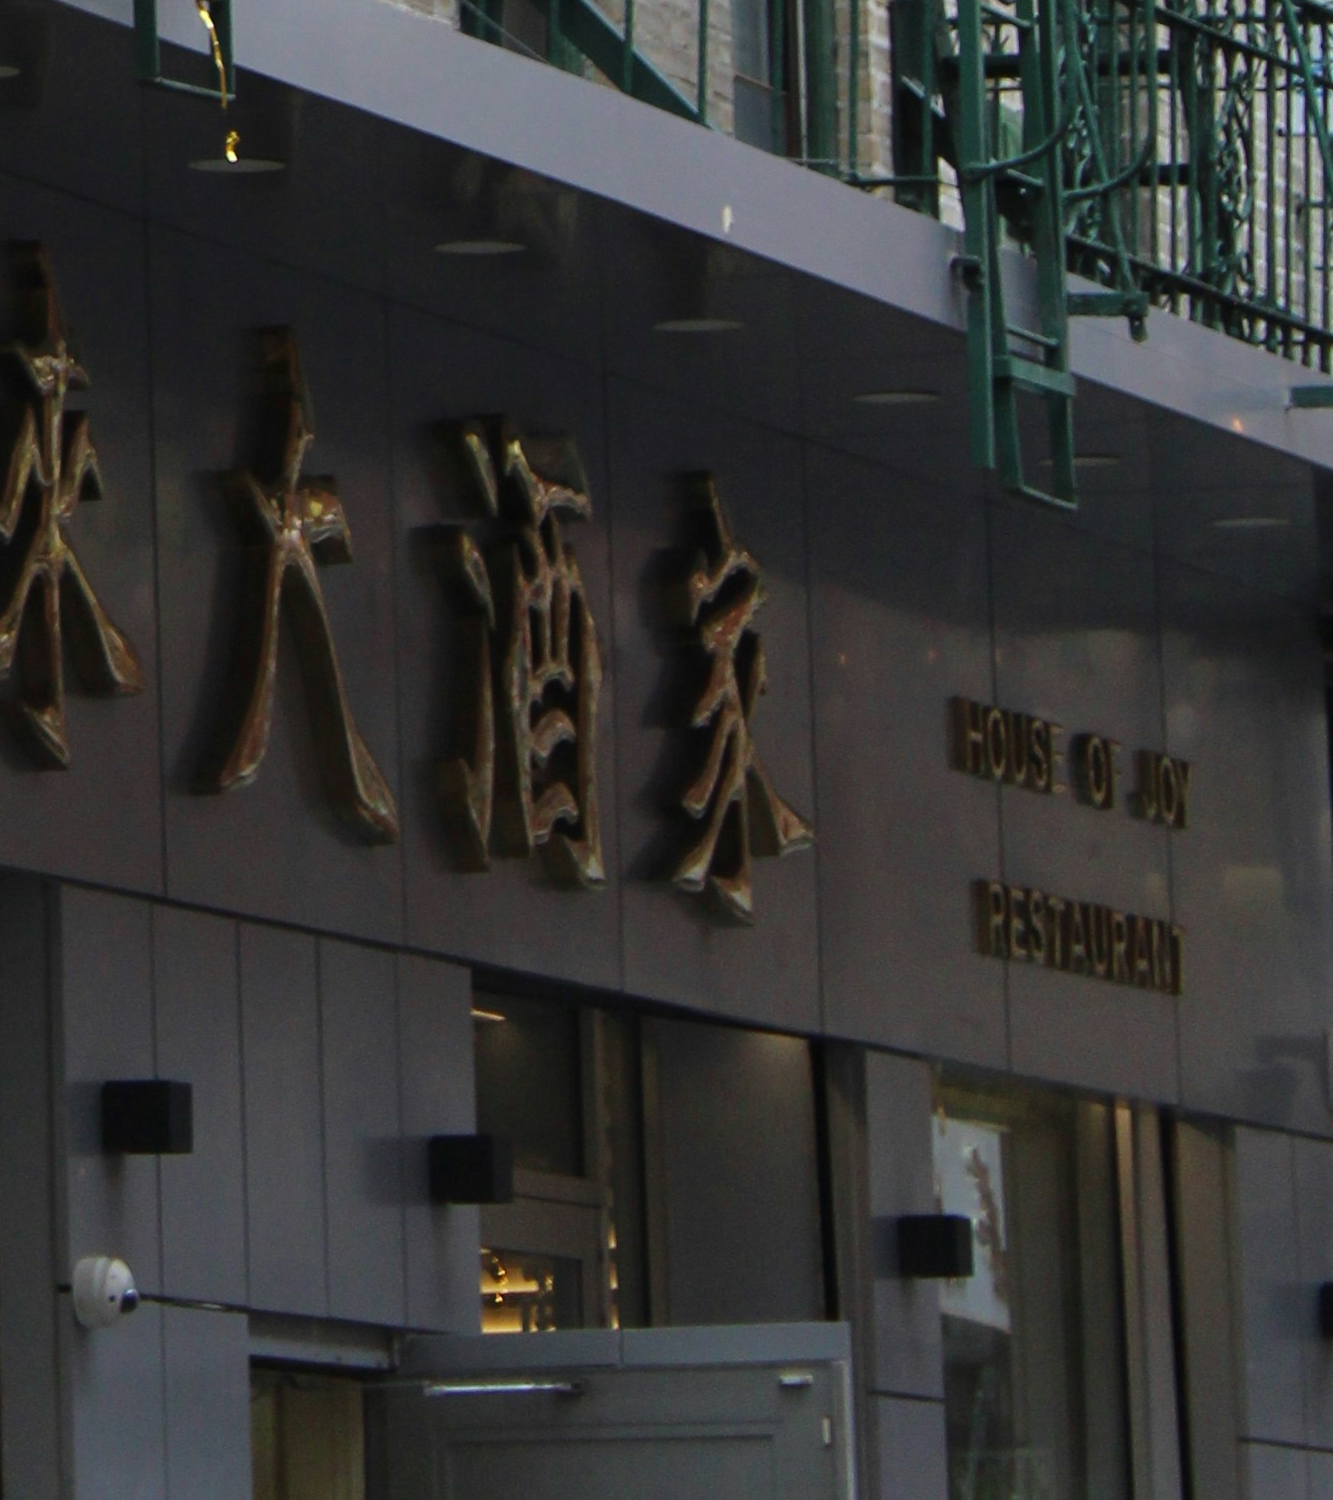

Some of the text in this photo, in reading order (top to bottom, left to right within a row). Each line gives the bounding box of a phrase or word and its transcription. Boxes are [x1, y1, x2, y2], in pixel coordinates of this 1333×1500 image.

[951, 698, 1191, 830] HOUSE OF JOY
[975, 879, 1186, 995] RESTAURANT
